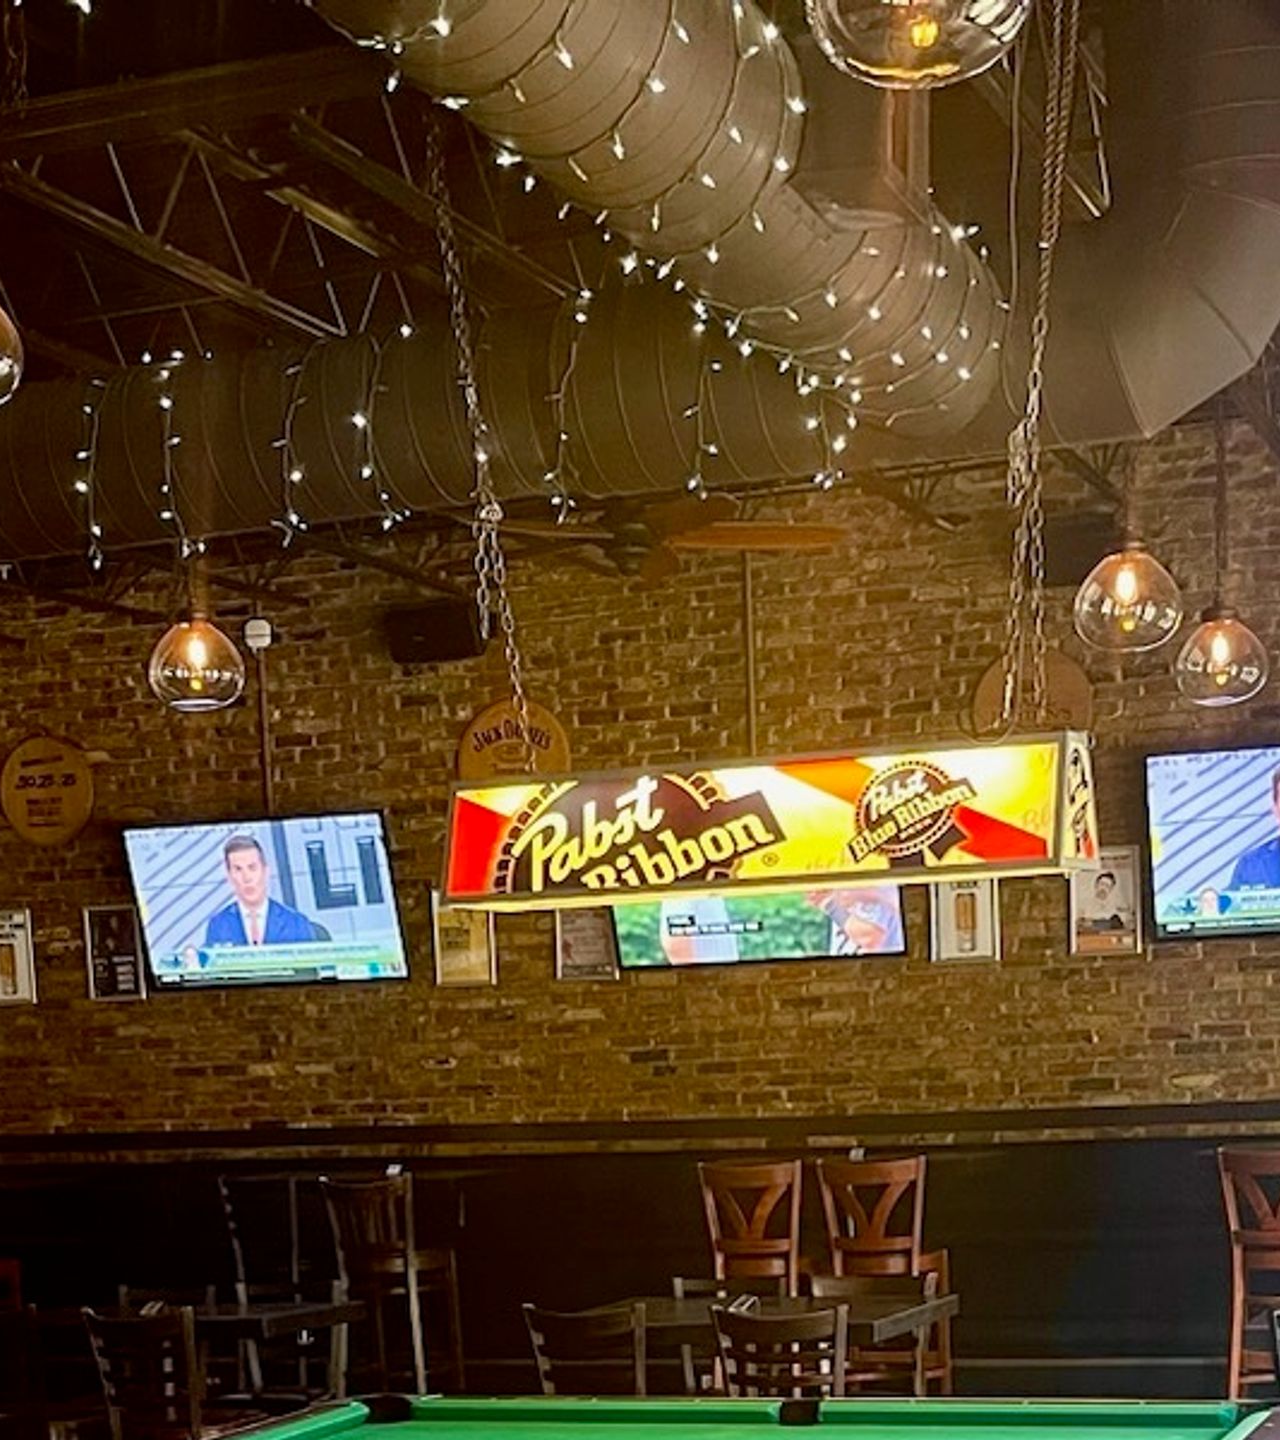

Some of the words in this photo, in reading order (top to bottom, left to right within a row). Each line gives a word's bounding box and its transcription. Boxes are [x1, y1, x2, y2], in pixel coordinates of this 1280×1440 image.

[511, 773, 665, 892] Pabst
[848, 819, 899, 862] Blue
[892, 783, 973, 833] Ribbon
[865, 768, 930, 823] Pabst
